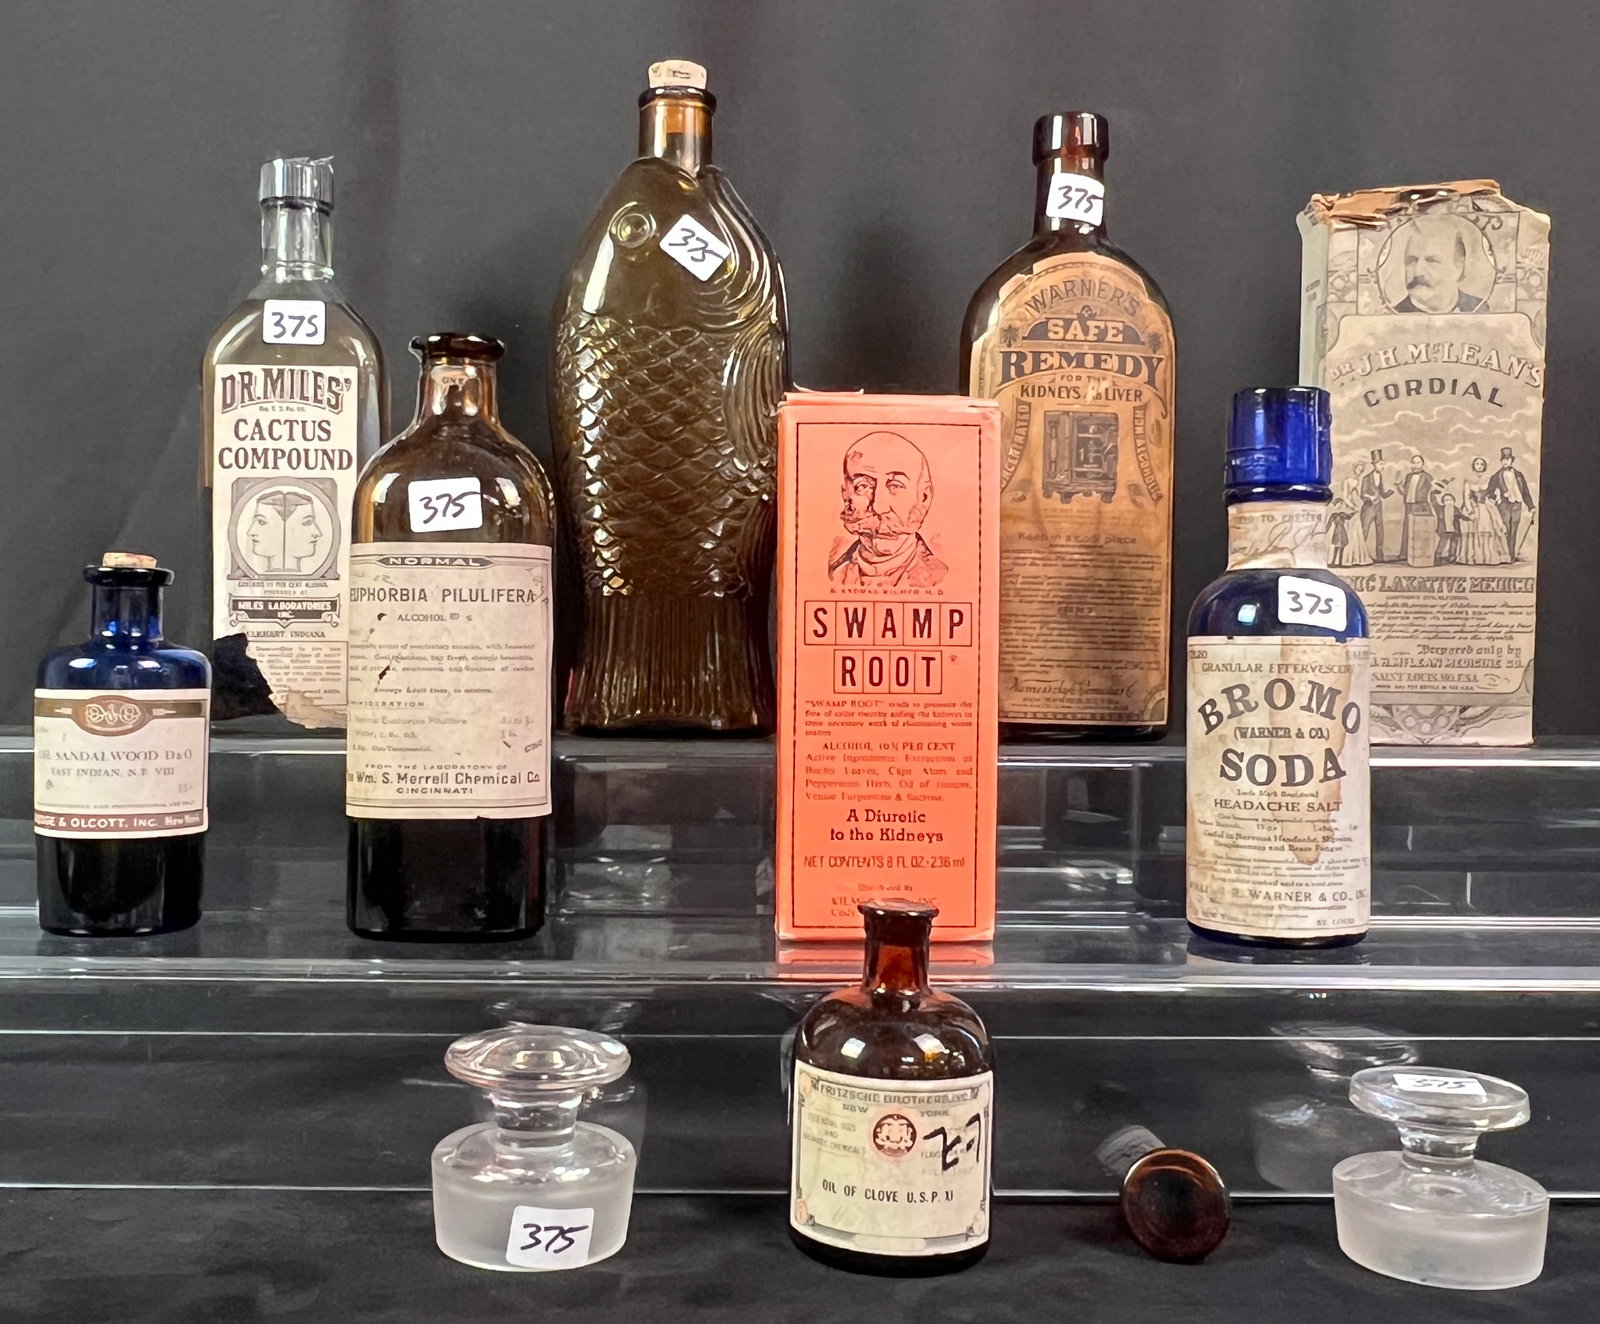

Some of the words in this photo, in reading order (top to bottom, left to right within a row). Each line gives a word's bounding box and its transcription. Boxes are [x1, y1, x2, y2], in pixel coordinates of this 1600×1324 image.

[1058, 185, 1103, 213] 375
[1024, 278, 1140, 317] WARNER'S
[271, 311, 319, 338] 375
[1047, 319, 1124, 343] SAFE
[998, 351, 1165, 391] REMEDY
[1020, 385, 1080, 400] KIDNEYS
[1105, 389, 1142, 402] LIVER
[1363, 377, 1504, 408] CORDIAL
[233, 418, 332, 442] CACTUS
[218, 447, 353, 470] COMPOUND
[419, 491, 481, 524] 375
[389, 557, 481, 566] NORMAL
[442, 588, 535, 604] PILULIFERA
[1287, 590, 1334, 615] 375
[238, 601, 264, 611] MILES
[267, 601, 332, 611] LABORATORIES
[397, 613, 446, 621] ALCOHOL
[812, 607, 964, 639] SWAMP
[290, 630, 326, 638] INDIANA
[841, 656, 936, 687] ROOT
[1202, 663, 1263, 673] GRANULAR
[1198, 677, 1361, 736] BROMO
[1233, 727, 1292, 740] (WARNER
[1295, 727, 1305, 739] &
[927, 742, 956, 751] CENT
[55, 750, 159, 761] SANDALWOOD
[805, 753, 835, 762] Active
[1219, 747, 1347, 787] SODA
[357, 771, 377, 784] Wm.
[382, 772, 393, 784] S.
[397, 772, 449, 785] Merrell
[455, 772, 522, 785] Chemical
[1214, 799, 1300, 812] HEADACHE
[1306, 801, 1343, 812] SALT
[58, 815, 67, 827] &
[70, 815, 129, 829] OLCOTT,
[846, 809, 859, 822] A
[864, 808, 926, 823] Diuretic
[830, 828, 845, 841] to
[850, 828, 874, 841] the
[880, 828, 943, 844] Kidneys
[804, 855, 824, 868] NET
[828, 855, 884, 868] CONTENTS
[886, 856, 893, 868] 8
[952, 856, 965, 867] ml
[1247, 889, 1312, 902] WARNER
[1319, 893, 1327, 901] &
[822, 1179, 837, 1194] OIL
[844, 1184, 857, 1197] OF
[864, 1188, 899, 1203] CLOVE
[520, 1223, 589, 1254] 375
